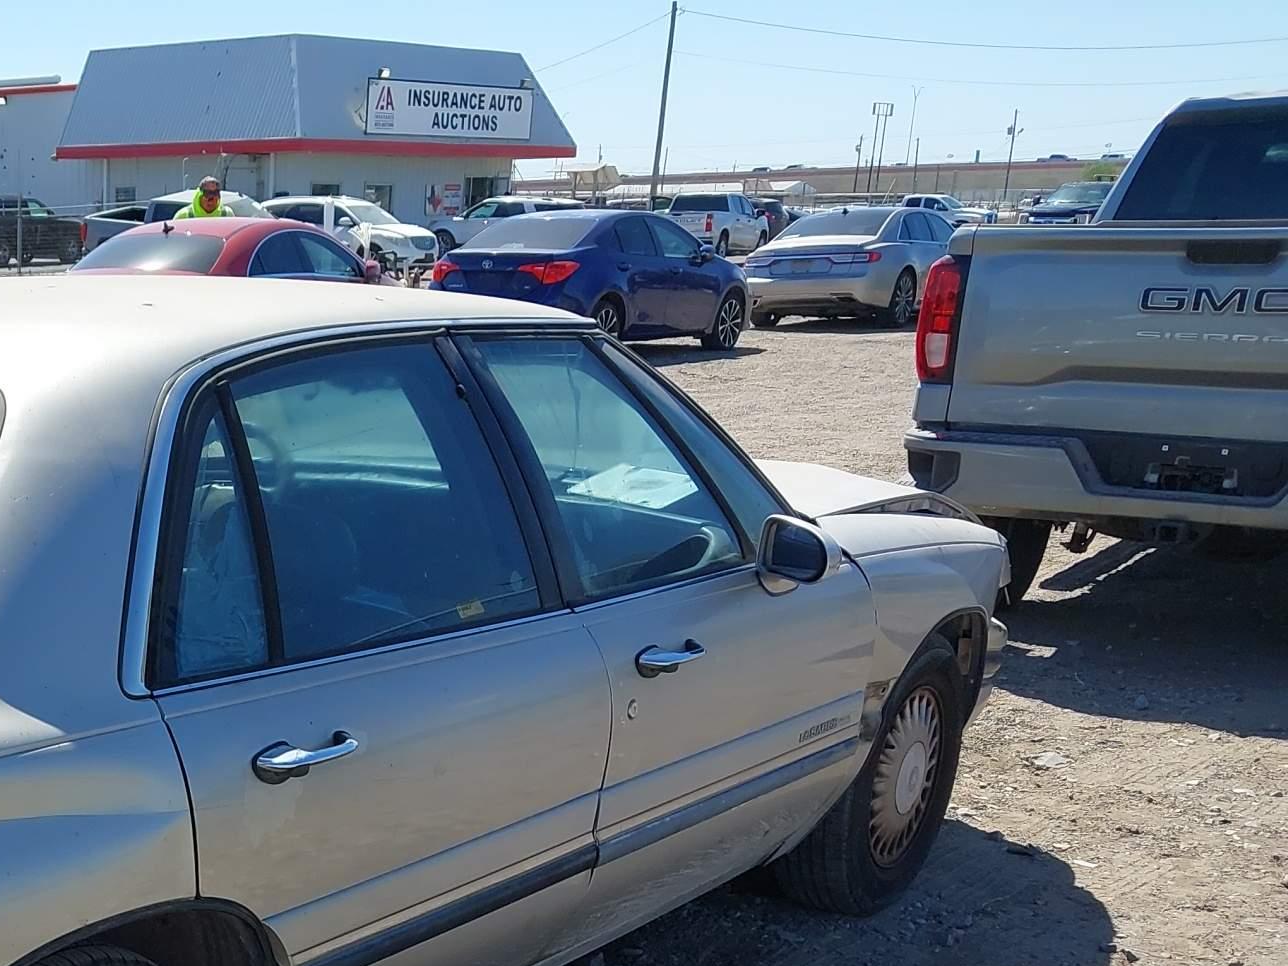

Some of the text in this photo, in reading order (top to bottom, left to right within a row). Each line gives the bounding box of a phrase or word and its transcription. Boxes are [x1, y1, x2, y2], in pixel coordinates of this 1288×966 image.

[407, 88, 523, 113] INSURANCE AUTO
[431, 111, 498, 132] AUCTIONS
[1139, 286, 1288, 314] GMC
